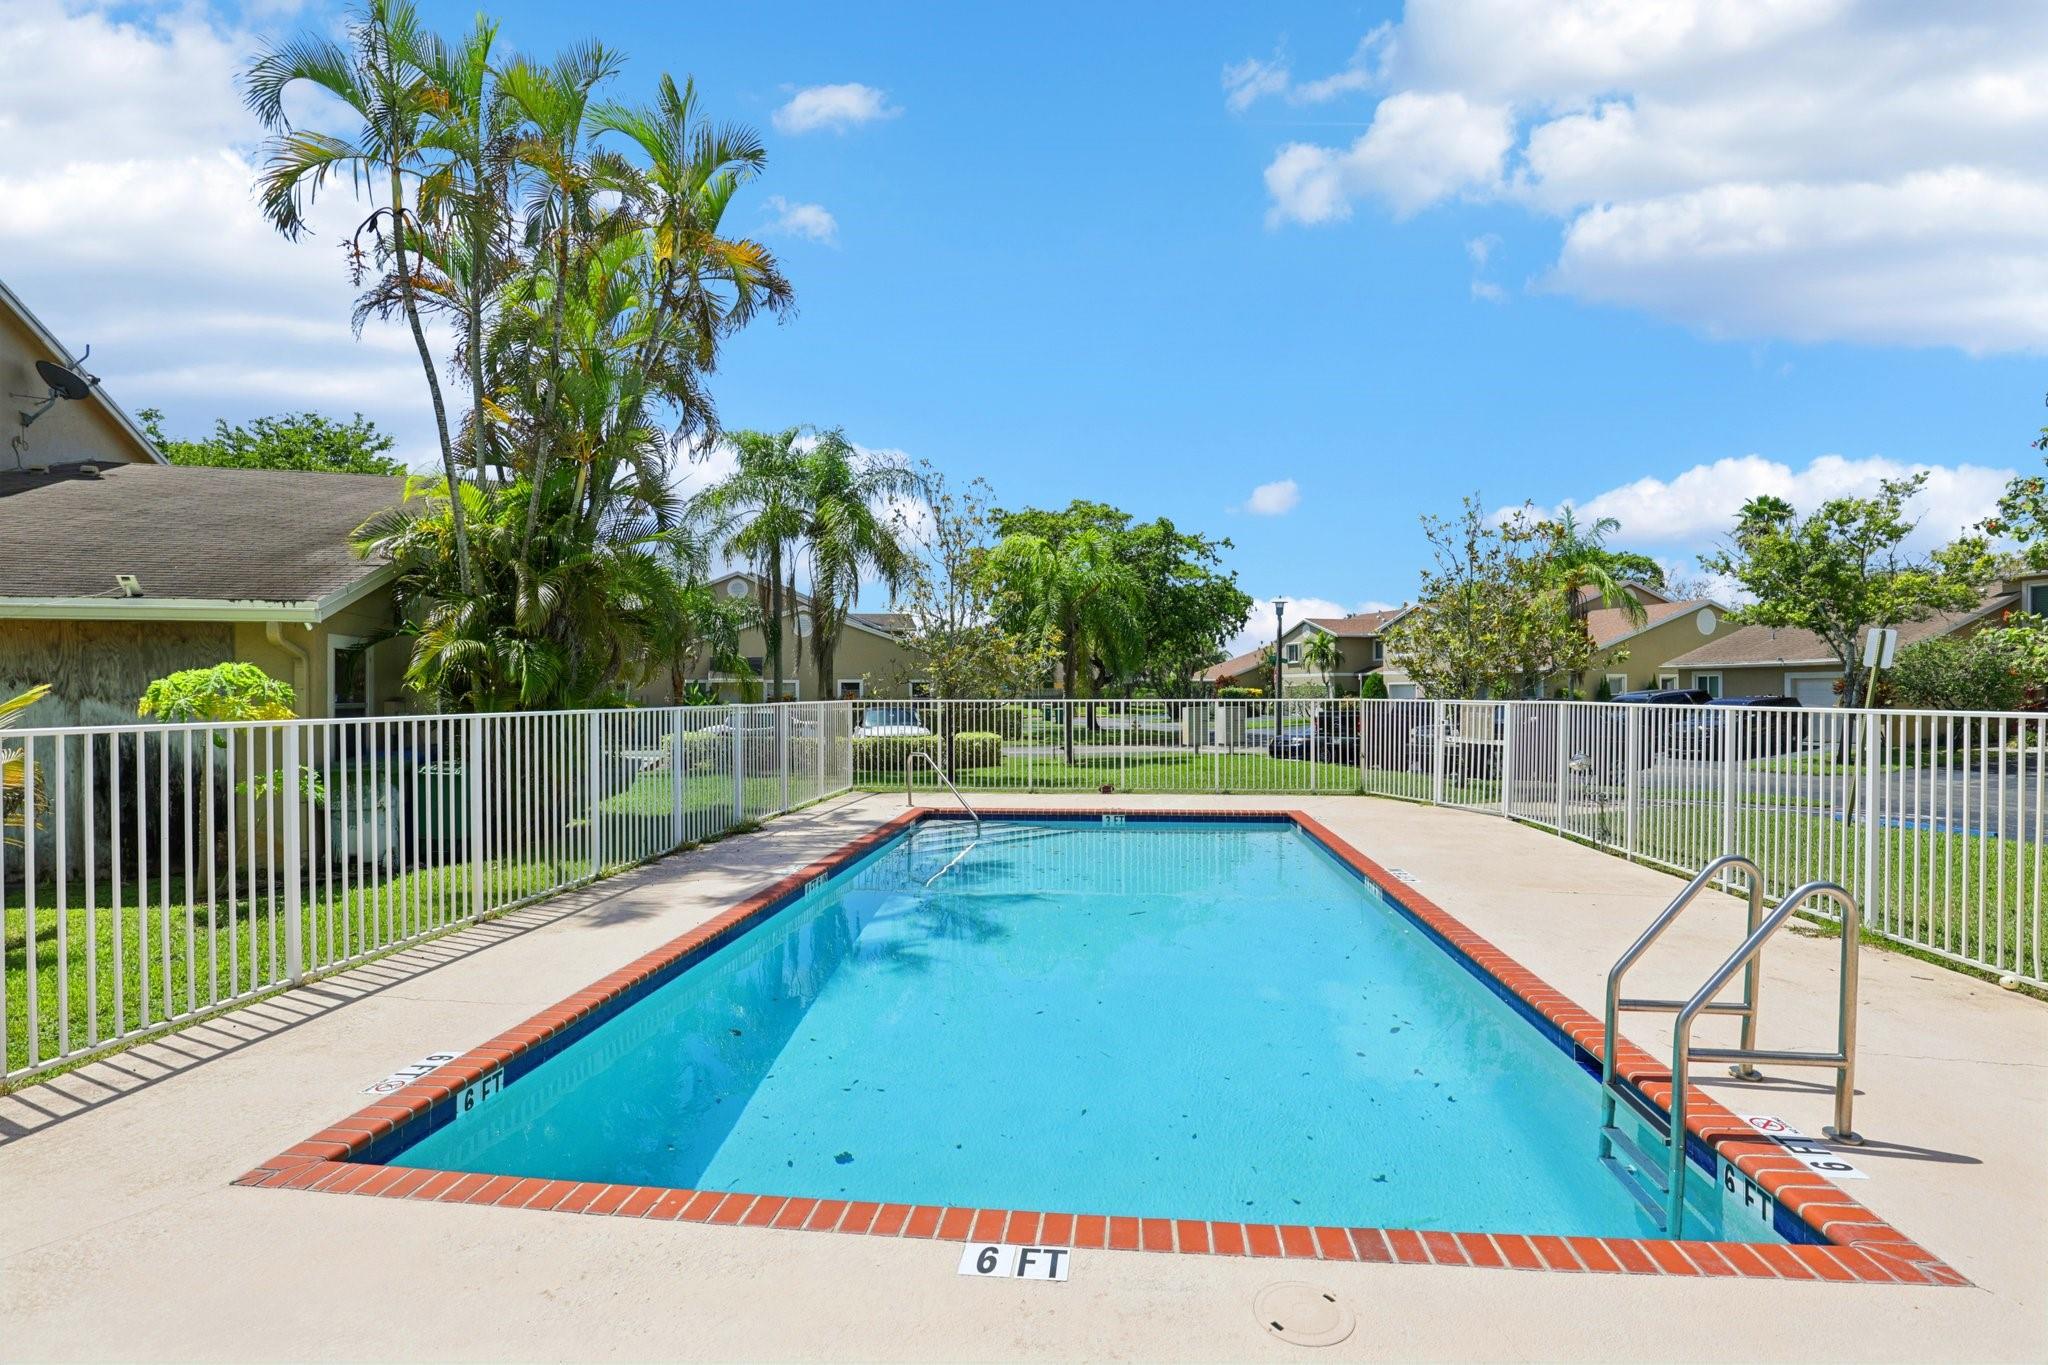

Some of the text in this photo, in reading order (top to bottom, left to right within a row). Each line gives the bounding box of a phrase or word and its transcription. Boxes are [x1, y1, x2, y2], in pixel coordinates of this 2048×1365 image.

[464, 1070, 503, 1111] 6 FT
[1770, 1134, 1853, 1171] 6 FT
[1724, 1164, 1771, 1222] 6 FT
[976, 1246, 1068, 1278] 6 FT
